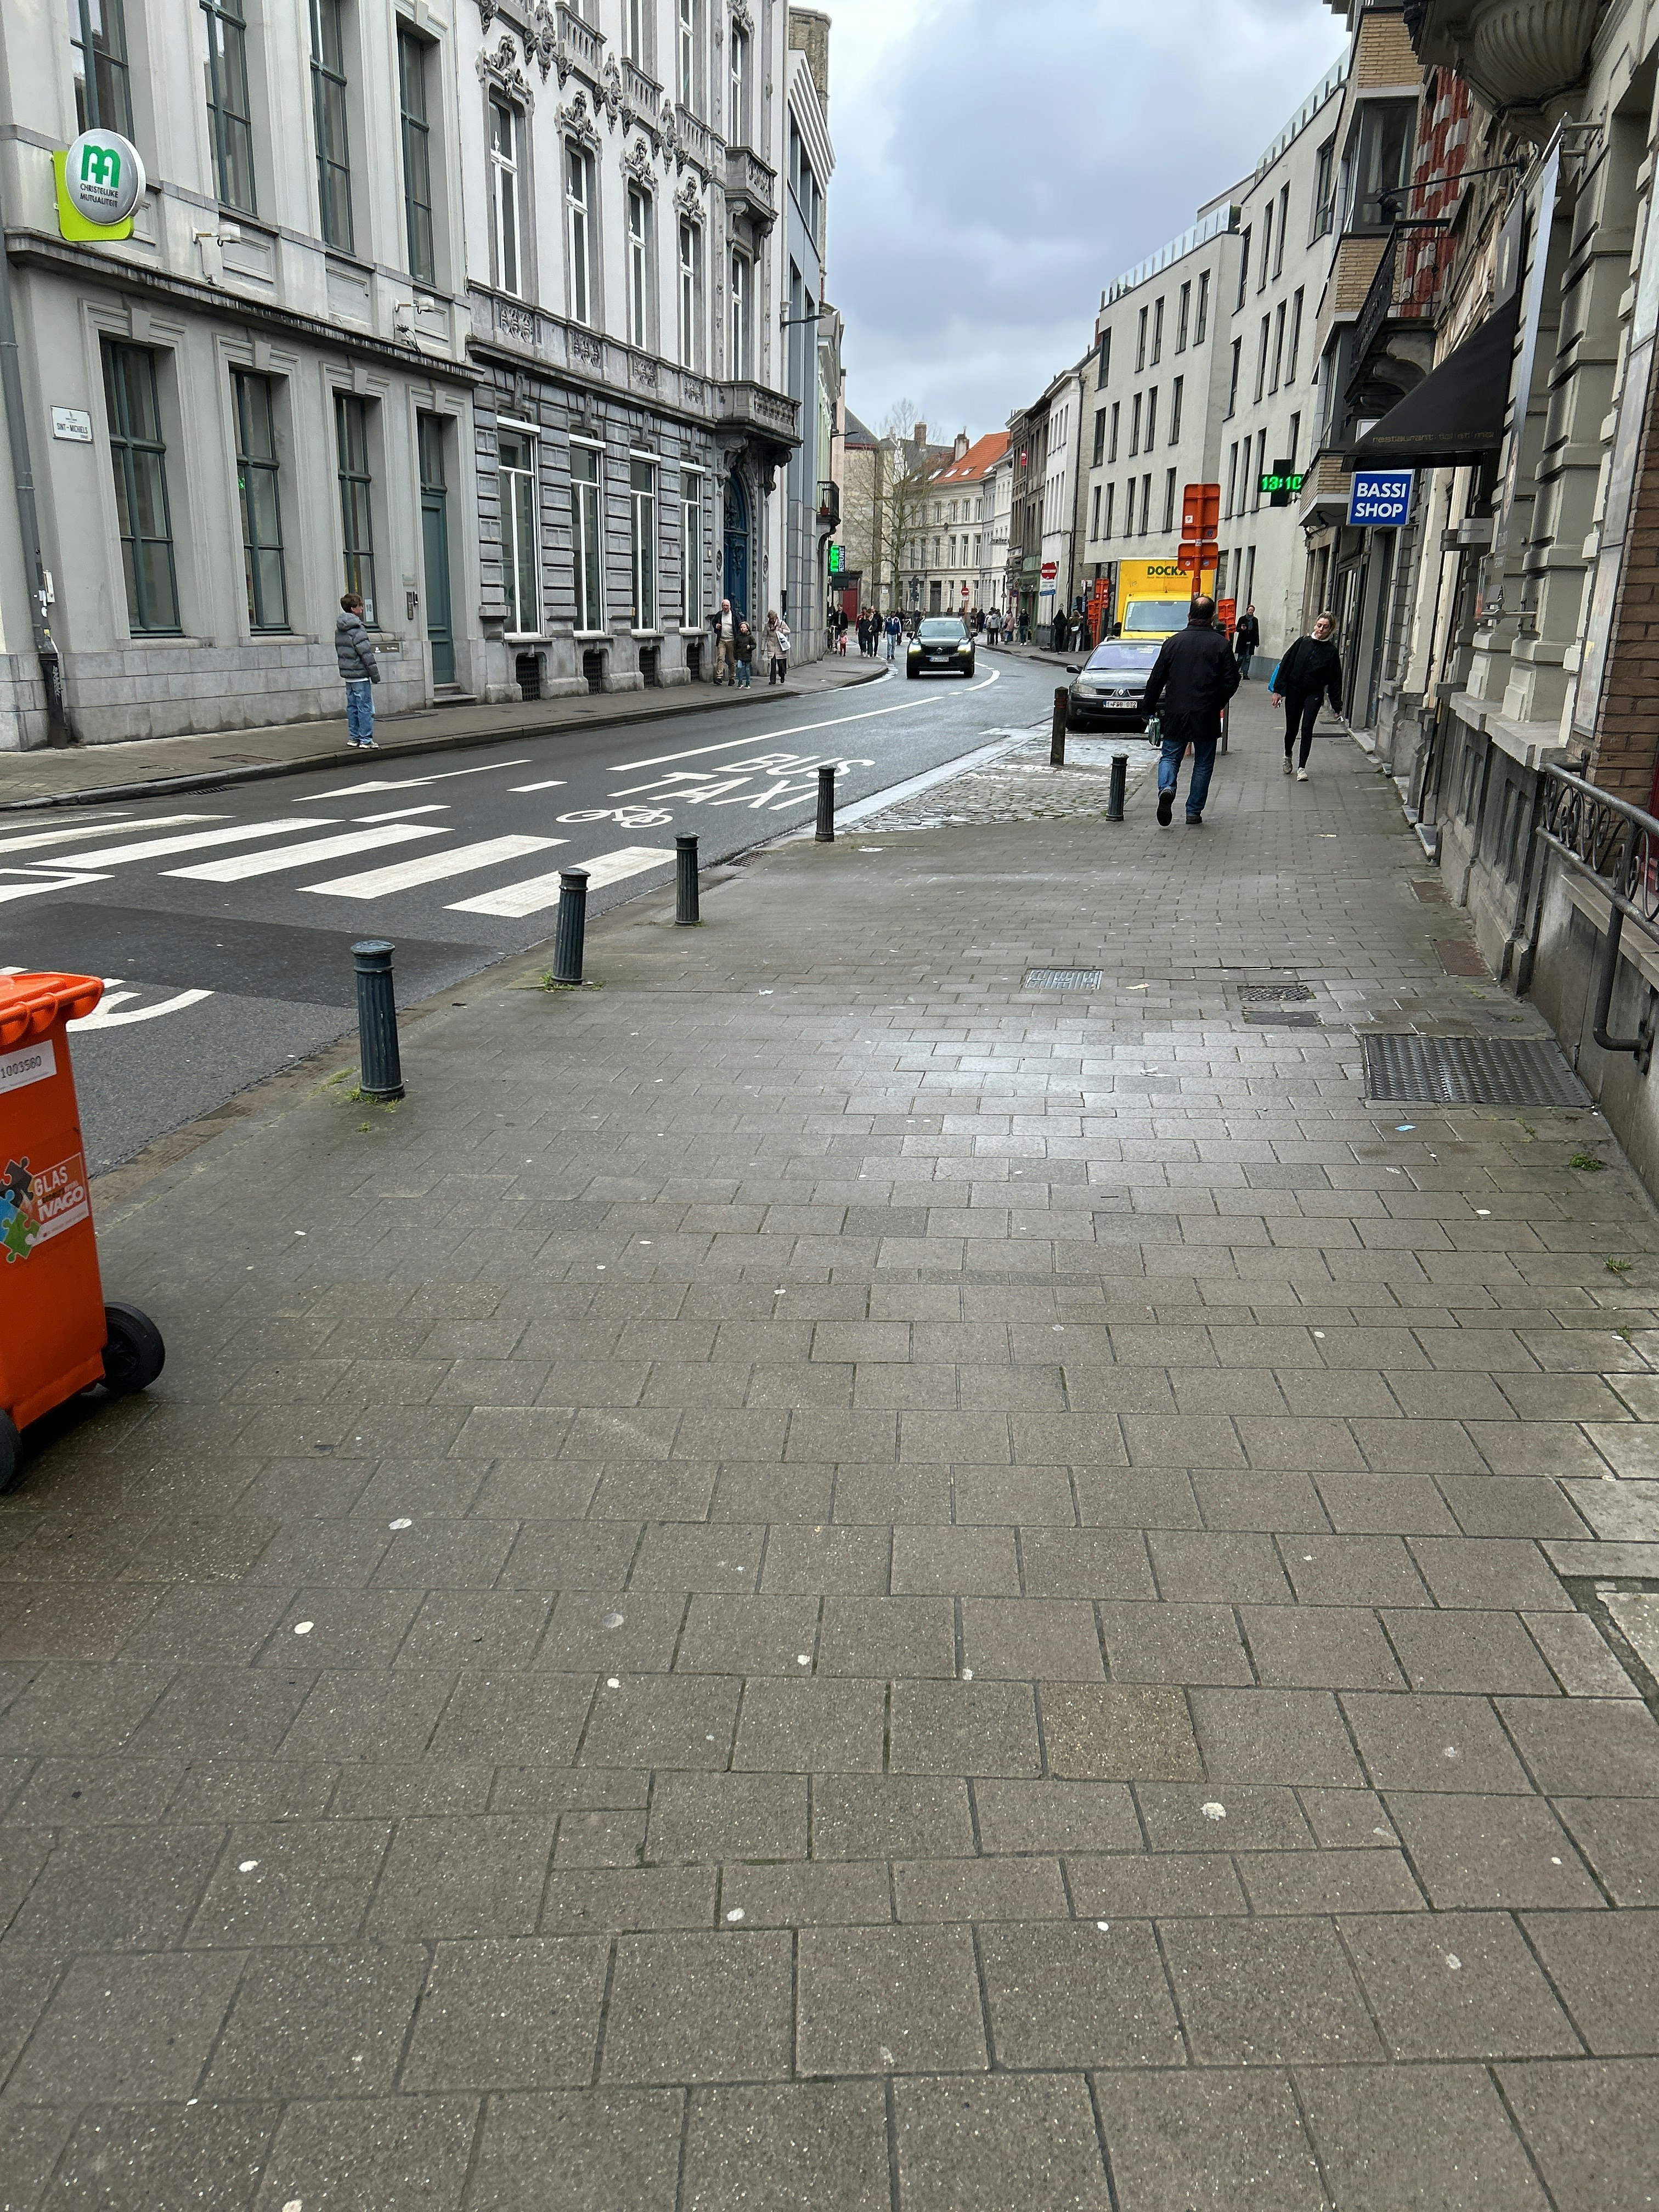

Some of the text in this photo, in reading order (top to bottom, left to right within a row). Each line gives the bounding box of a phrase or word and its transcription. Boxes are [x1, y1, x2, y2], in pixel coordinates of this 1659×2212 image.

[80, 183, 119, 198] CHRISTELIJKE
[80, 193, 119, 207] MUTUALITEIT
[1373, 434, 1433, 443] restaurant
[1262, 476, 1302, 490] 13:10
[1357, 483, 1407, 498] BASSI
[1355, 503, 1403, 517] SHOP
[831, 546, 839, 572] INDIAN
[1147, 566, 1187, 575] DOCKX
[712, 753, 875, 778] BUS
[607, 772, 844, 810] TAXI
[33, 1166, 68, 1197] GLAS
